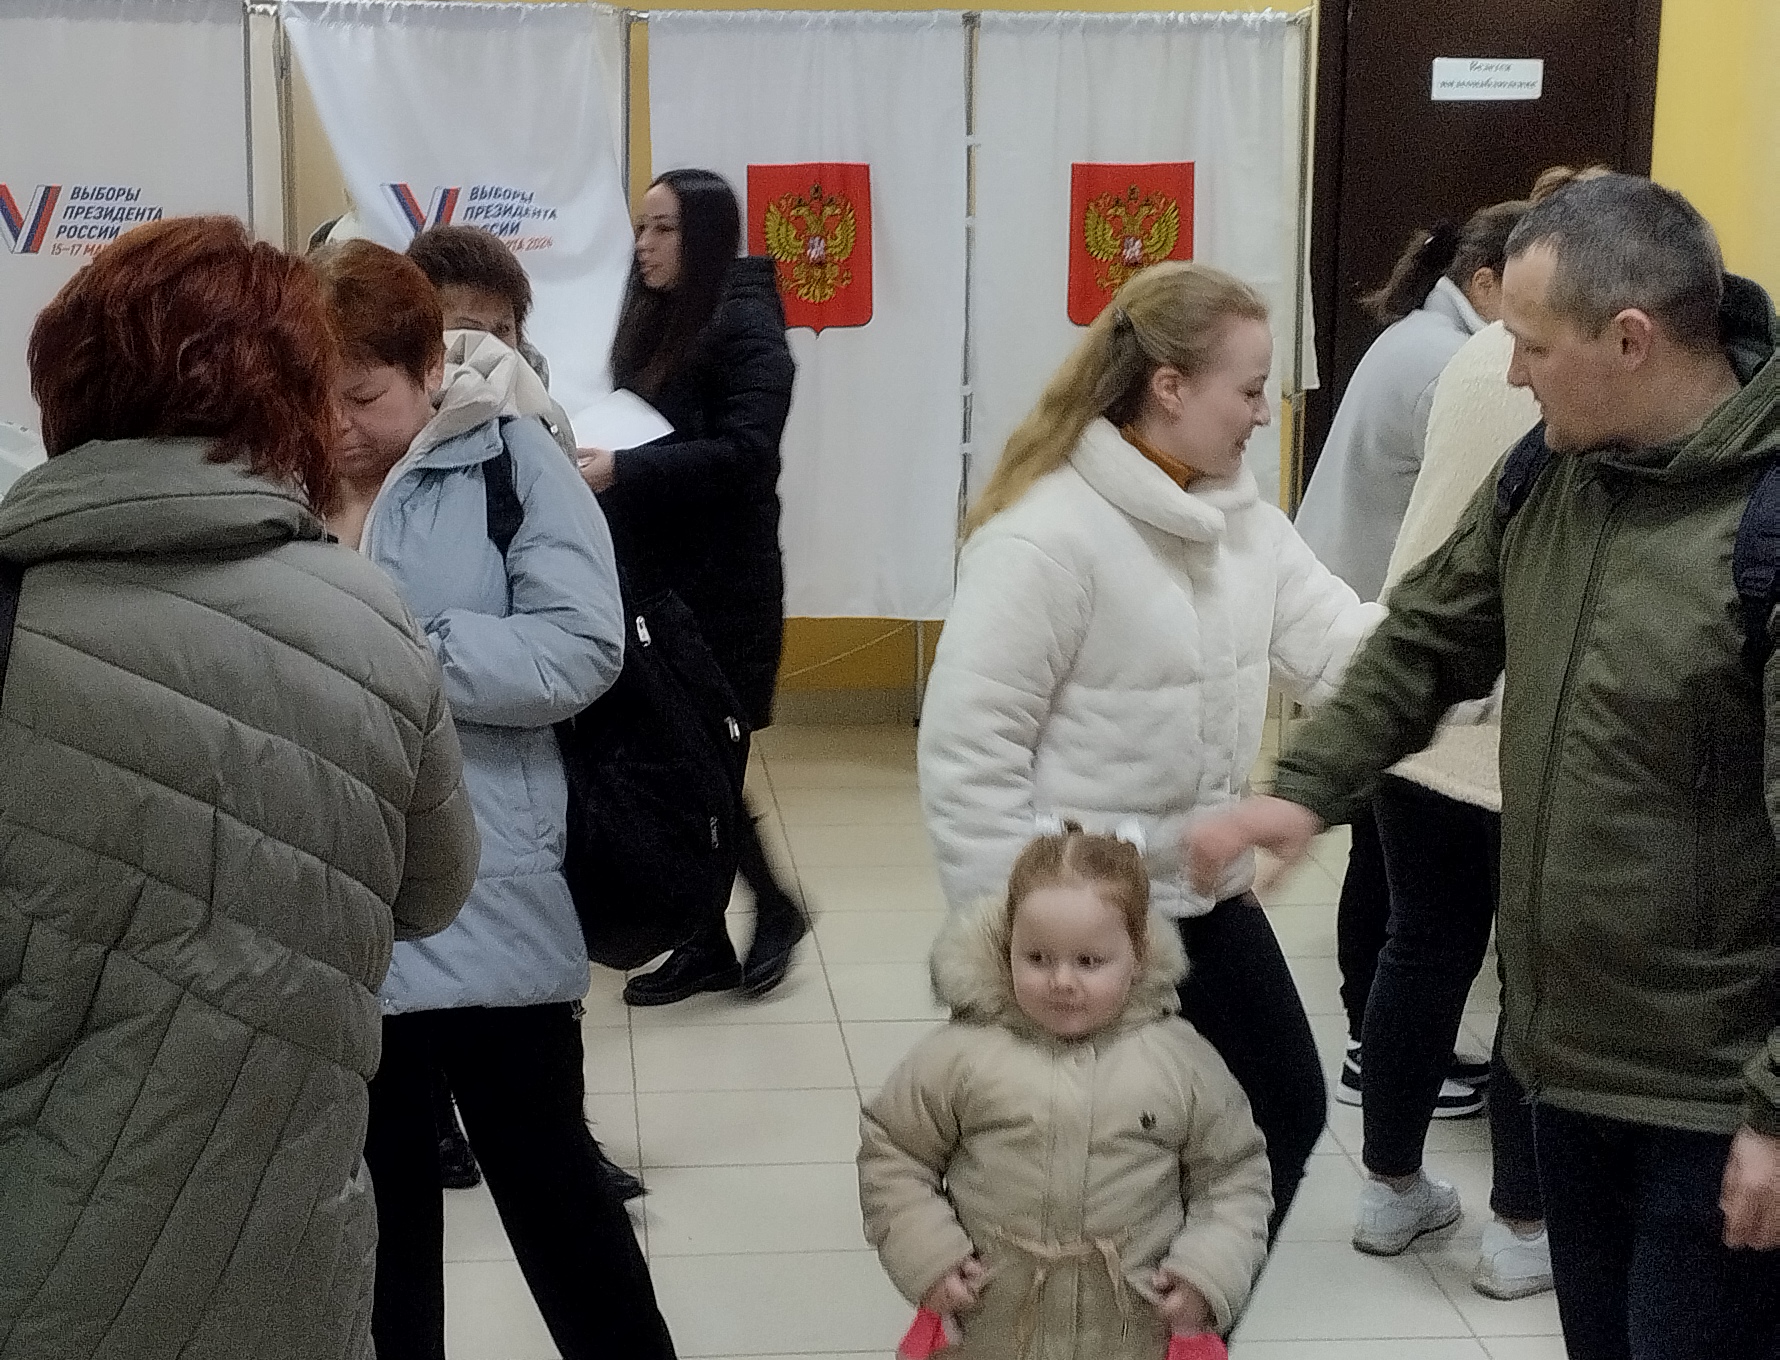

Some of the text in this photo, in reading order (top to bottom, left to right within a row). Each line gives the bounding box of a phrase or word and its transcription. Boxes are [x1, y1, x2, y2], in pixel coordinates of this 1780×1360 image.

[70, 186, 141, 202] ВЫБОРЫ
[469, 185, 534, 203] ВЫБОРЫ
[62, 205, 163, 222] ПРЕЗИДЕНТА
[462, 204, 558, 221] ПРЕЗИДЕНТА
[55, 224, 120, 240] РОССИИ
